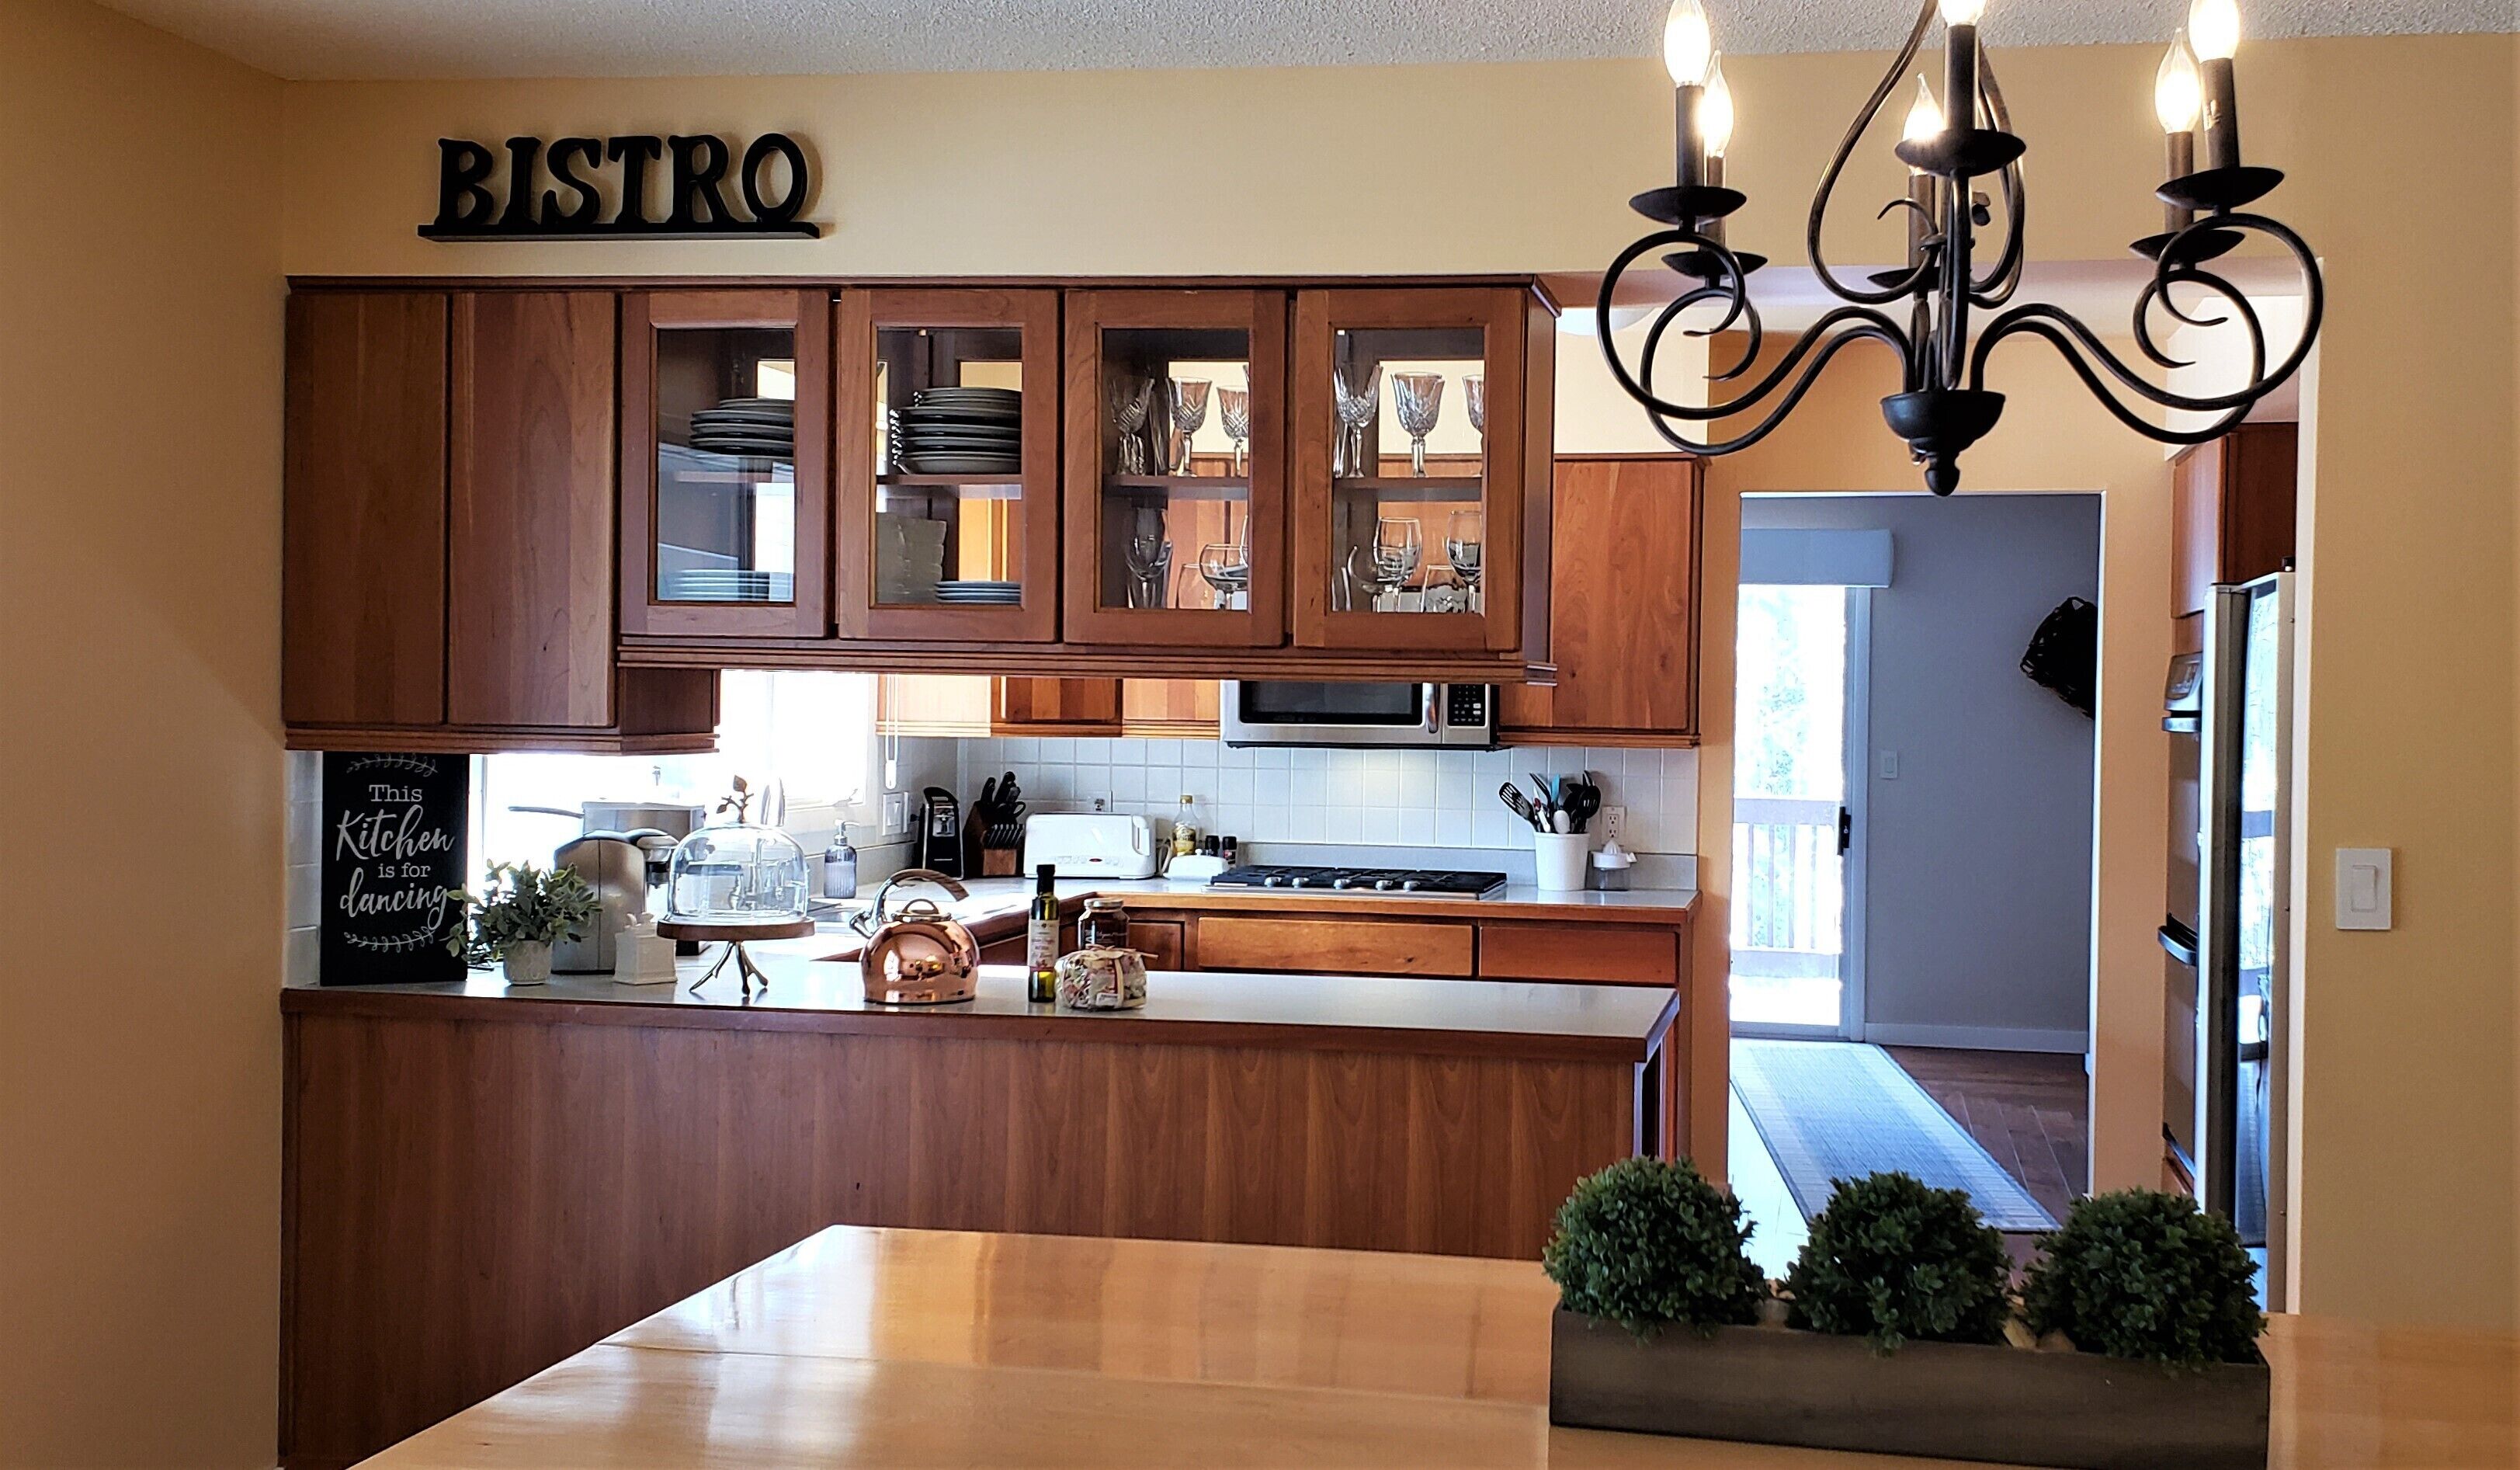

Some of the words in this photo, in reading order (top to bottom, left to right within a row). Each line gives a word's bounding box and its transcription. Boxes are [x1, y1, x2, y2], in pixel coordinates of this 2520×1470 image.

[438, 133, 808, 225] BISTRO
[369, 784, 423, 803] This
[336, 804, 456, 861] Kitchen
[378, 863, 395, 878] is
[401, 862, 431, 878] for
[339, 867, 448, 931] dancing
